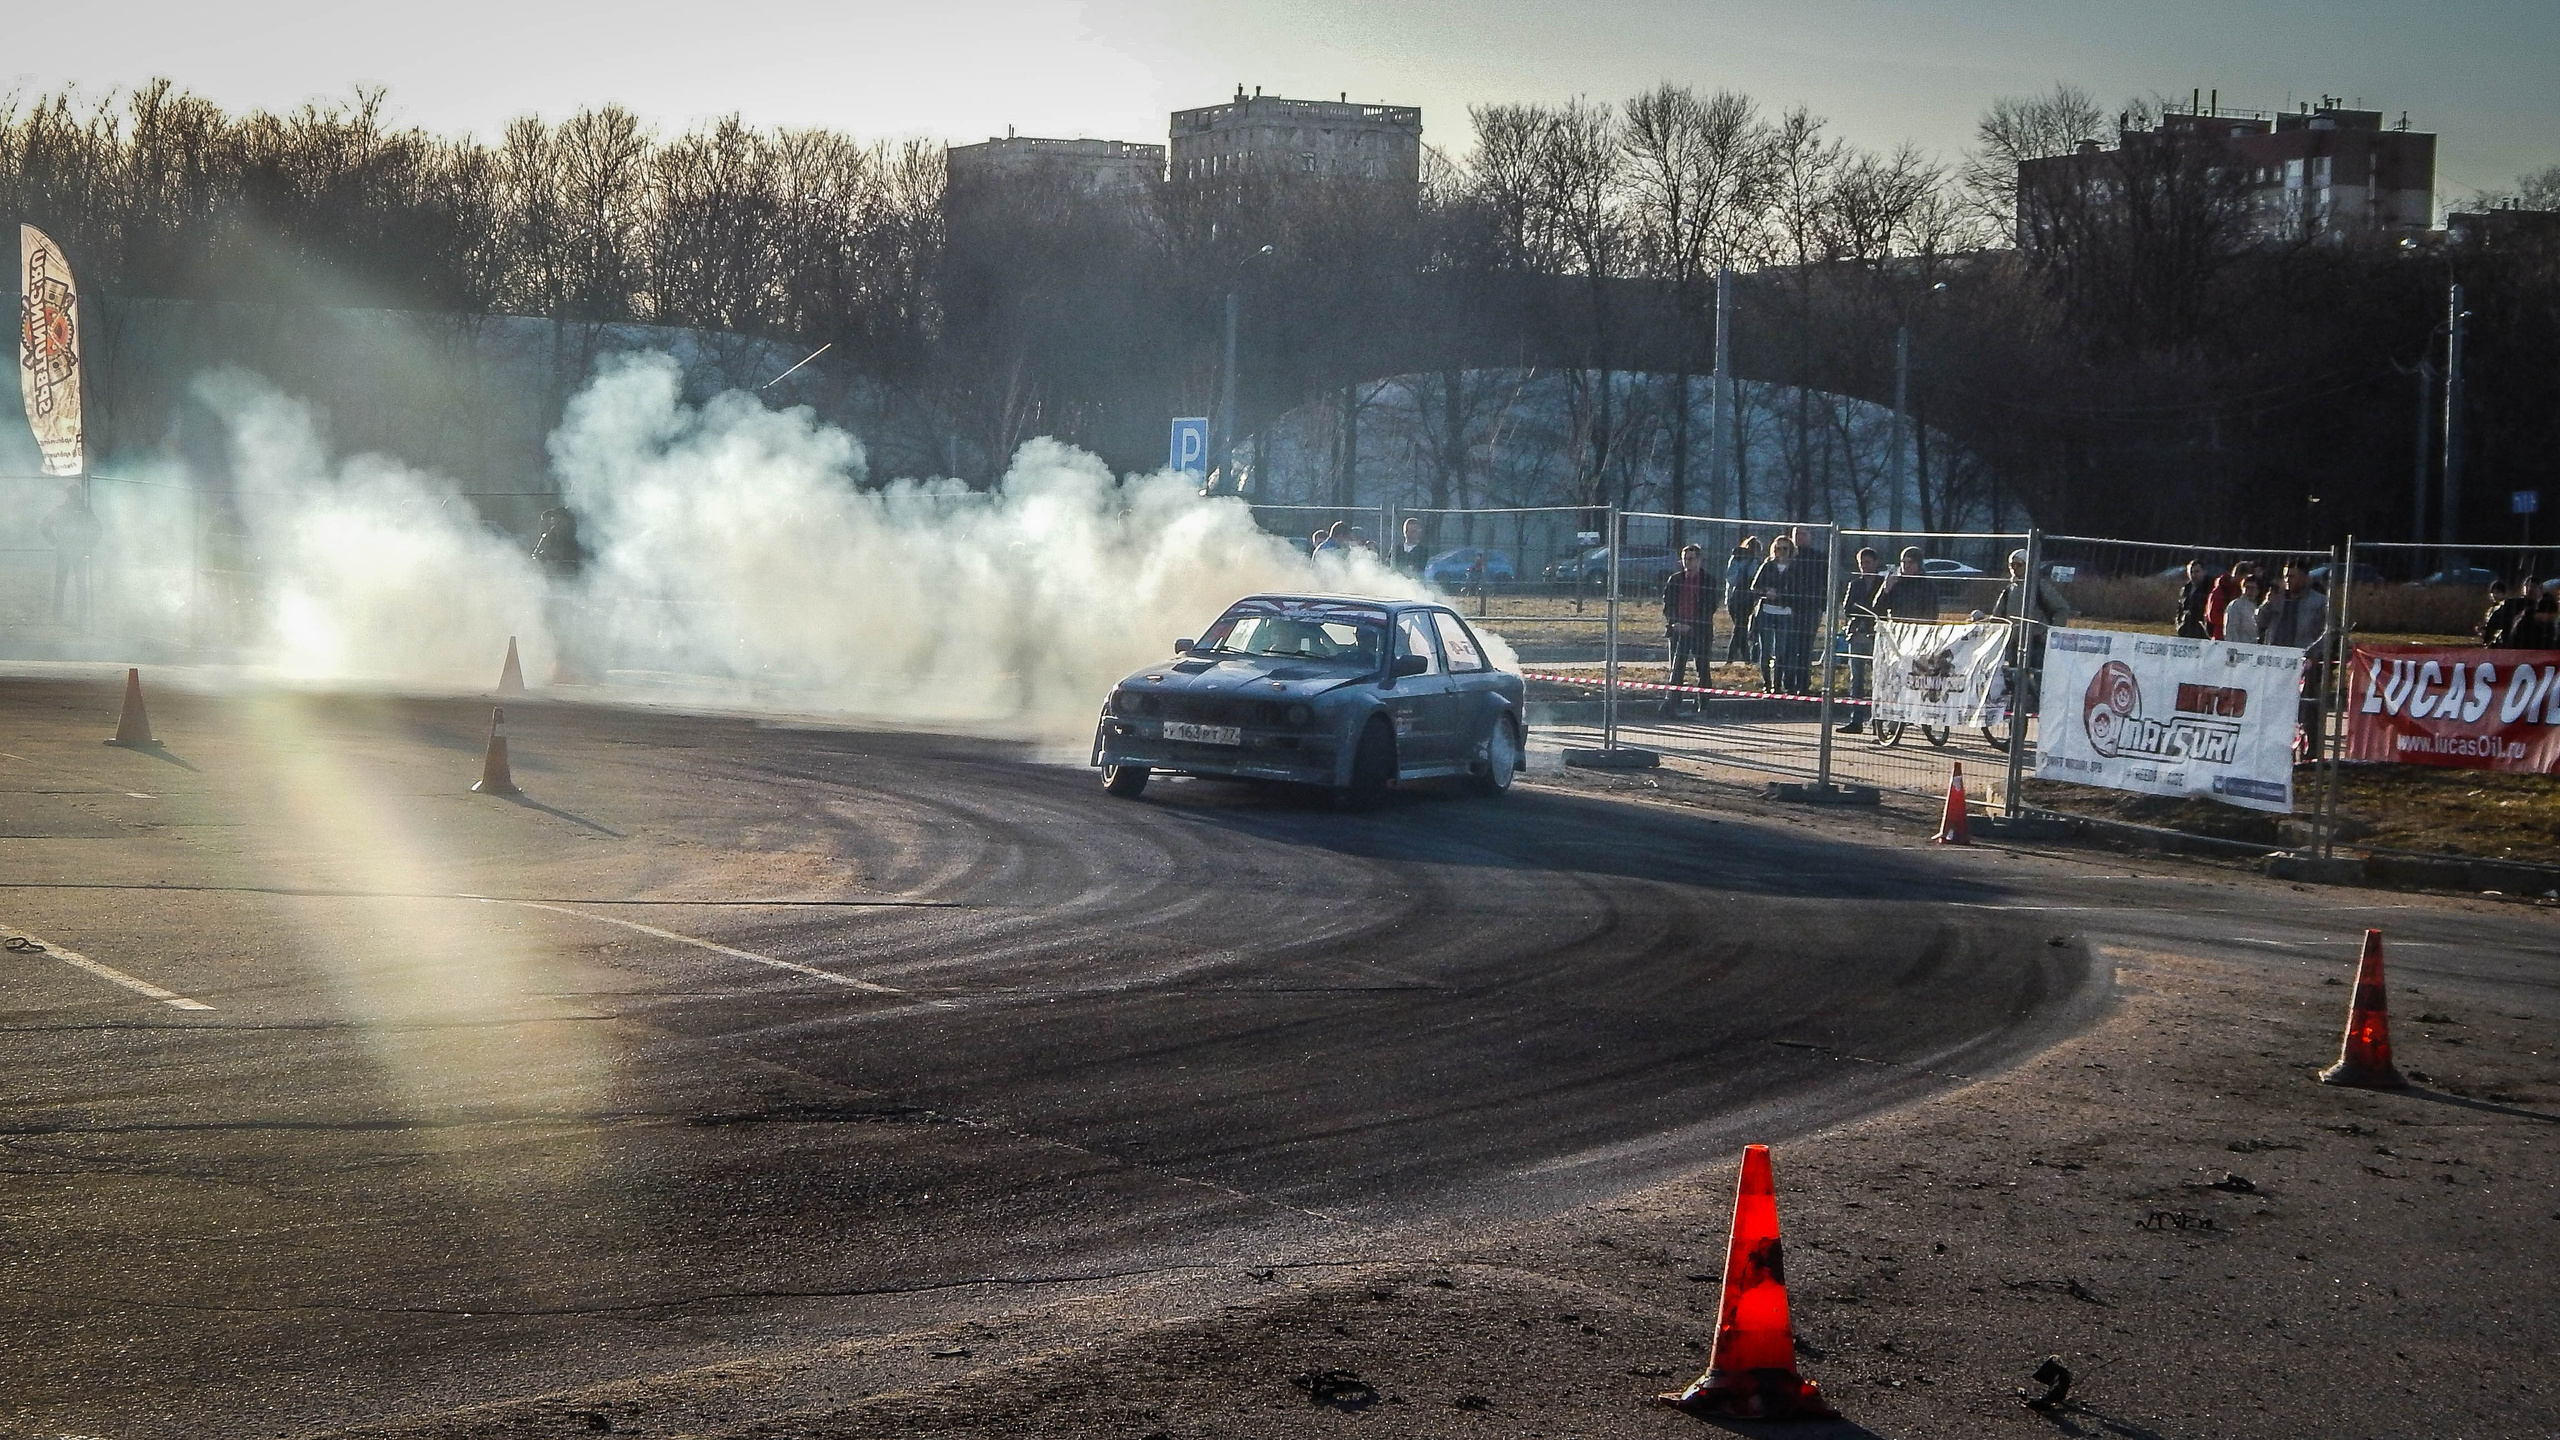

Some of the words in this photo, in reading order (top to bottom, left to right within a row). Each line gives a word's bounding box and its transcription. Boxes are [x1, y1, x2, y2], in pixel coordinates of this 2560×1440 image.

[1181, 428, 1200, 472] P
[2361, 658, 2497, 723] LUCAS
[2118, 717, 2240, 765] MATSURI
[2396, 733, 2526, 759] www.lucasOil.ru
